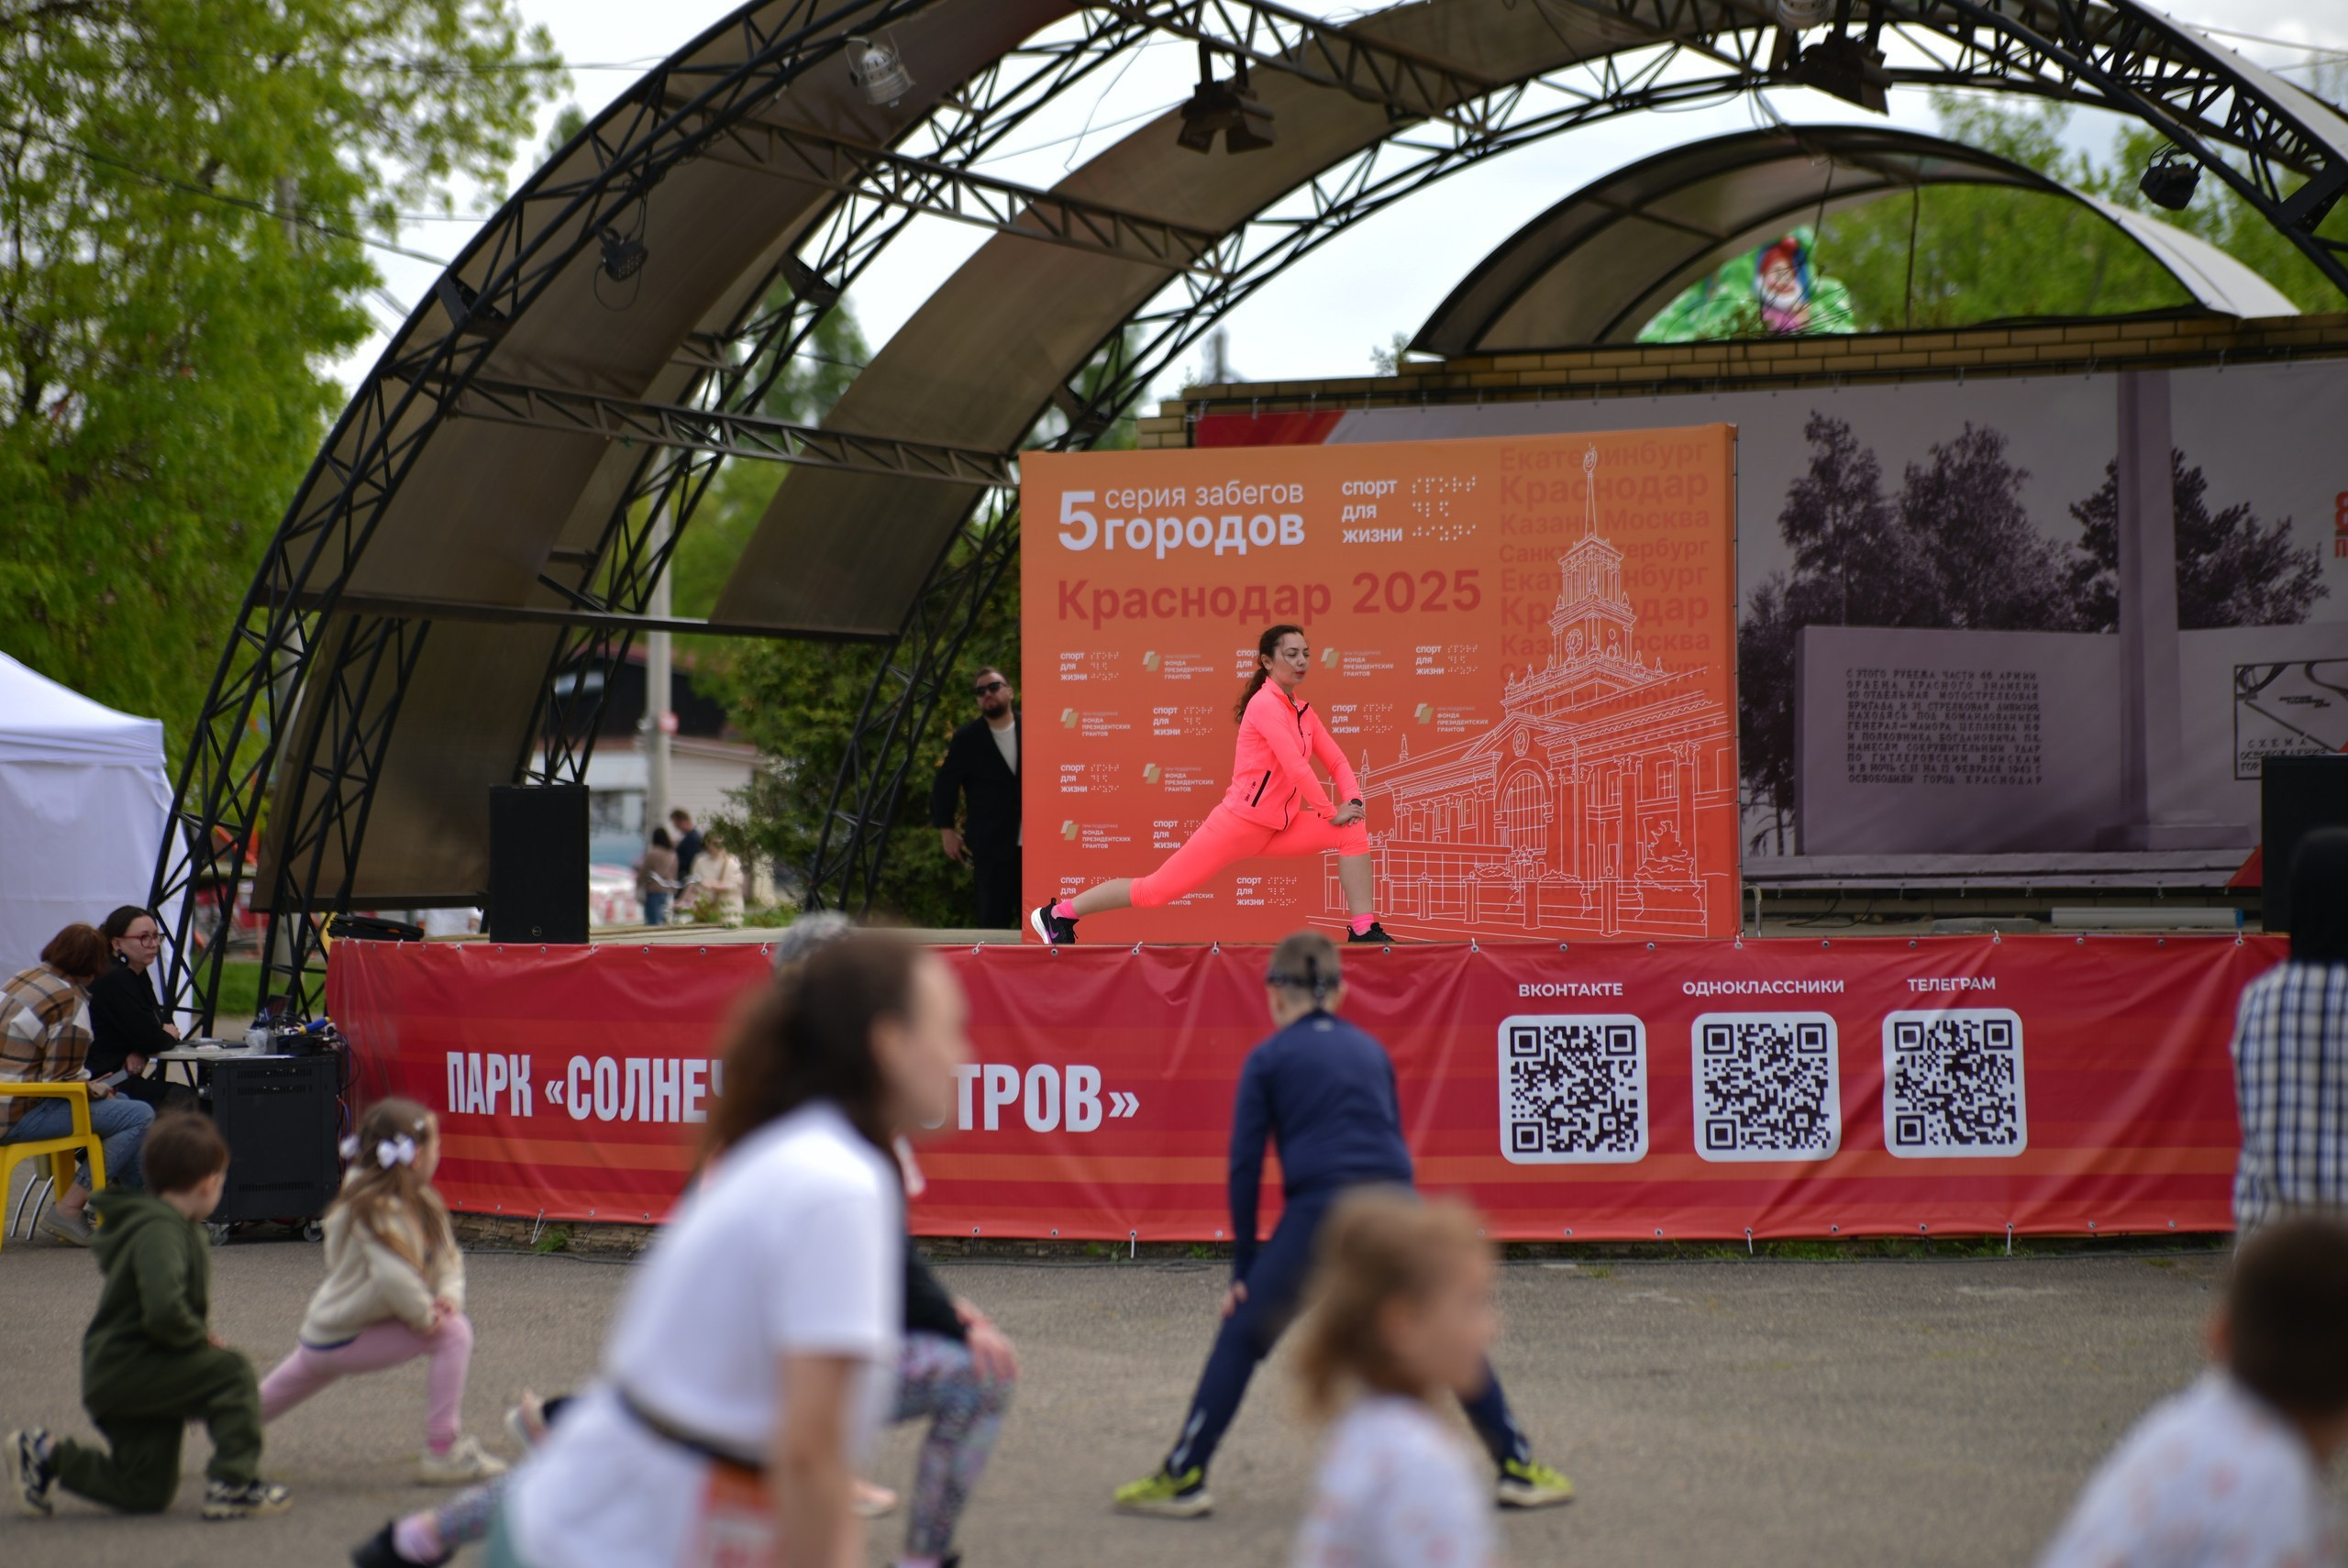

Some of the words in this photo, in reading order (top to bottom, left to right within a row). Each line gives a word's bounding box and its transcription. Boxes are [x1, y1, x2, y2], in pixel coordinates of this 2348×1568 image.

[1342, 480, 1397, 499] спорт
[1104, 487, 1186, 513] серия
[1195, 480, 1304, 506] забегов
[1342, 503, 1377, 522] для
[1058, 491, 1099, 551] 5
[1104, 513, 1306, 559] городов
[1604, 509, 1710, 532] Москва
[1342, 526, 1403, 544] жизни
[1058, 580, 1332, 630] Краснодар
[1353, 569, 1482, 614] 2025
[1415, 646, 1442, 655] спорт
[1060, 652, 1085, 661] спорт
[1235, 660, 1253, 668] для
[1415, 657, 1433, 666] для
[1060, 663, 1077, 671] для
[1153, 707, 1179, 716] спорт
[1332, 704, 1357, 713] спорт
[1153, 718, 1169, 726] для
[1331, 715, 1348, 723] для
[1060, 764, 1086, 773] спорт
[1060, 775, 1077, 783] для
[1153, 821, 1179, 830] спорт
[1153, 831, 1169, 839] для
[1060, 877, 1085, 886] спорт
[1236, 877, 1262, 886] спорт
[1060, 888, 1077, 896] для
[1236, 888, 1253, 896] для
[1236, 898, 1265, 906] жизни
[1682, 979, 1845, 996] ОДНОКЛАССНИКИ
[1907, 977, 1997, 992] ТЕЛЕГРАМ
[1518, 983, 1623, 997] ВКОНТАКТЕ
[446, 1051, 533, 1118] ПАРК
[920, 1064, 1140, 1133] ТРОВ»
